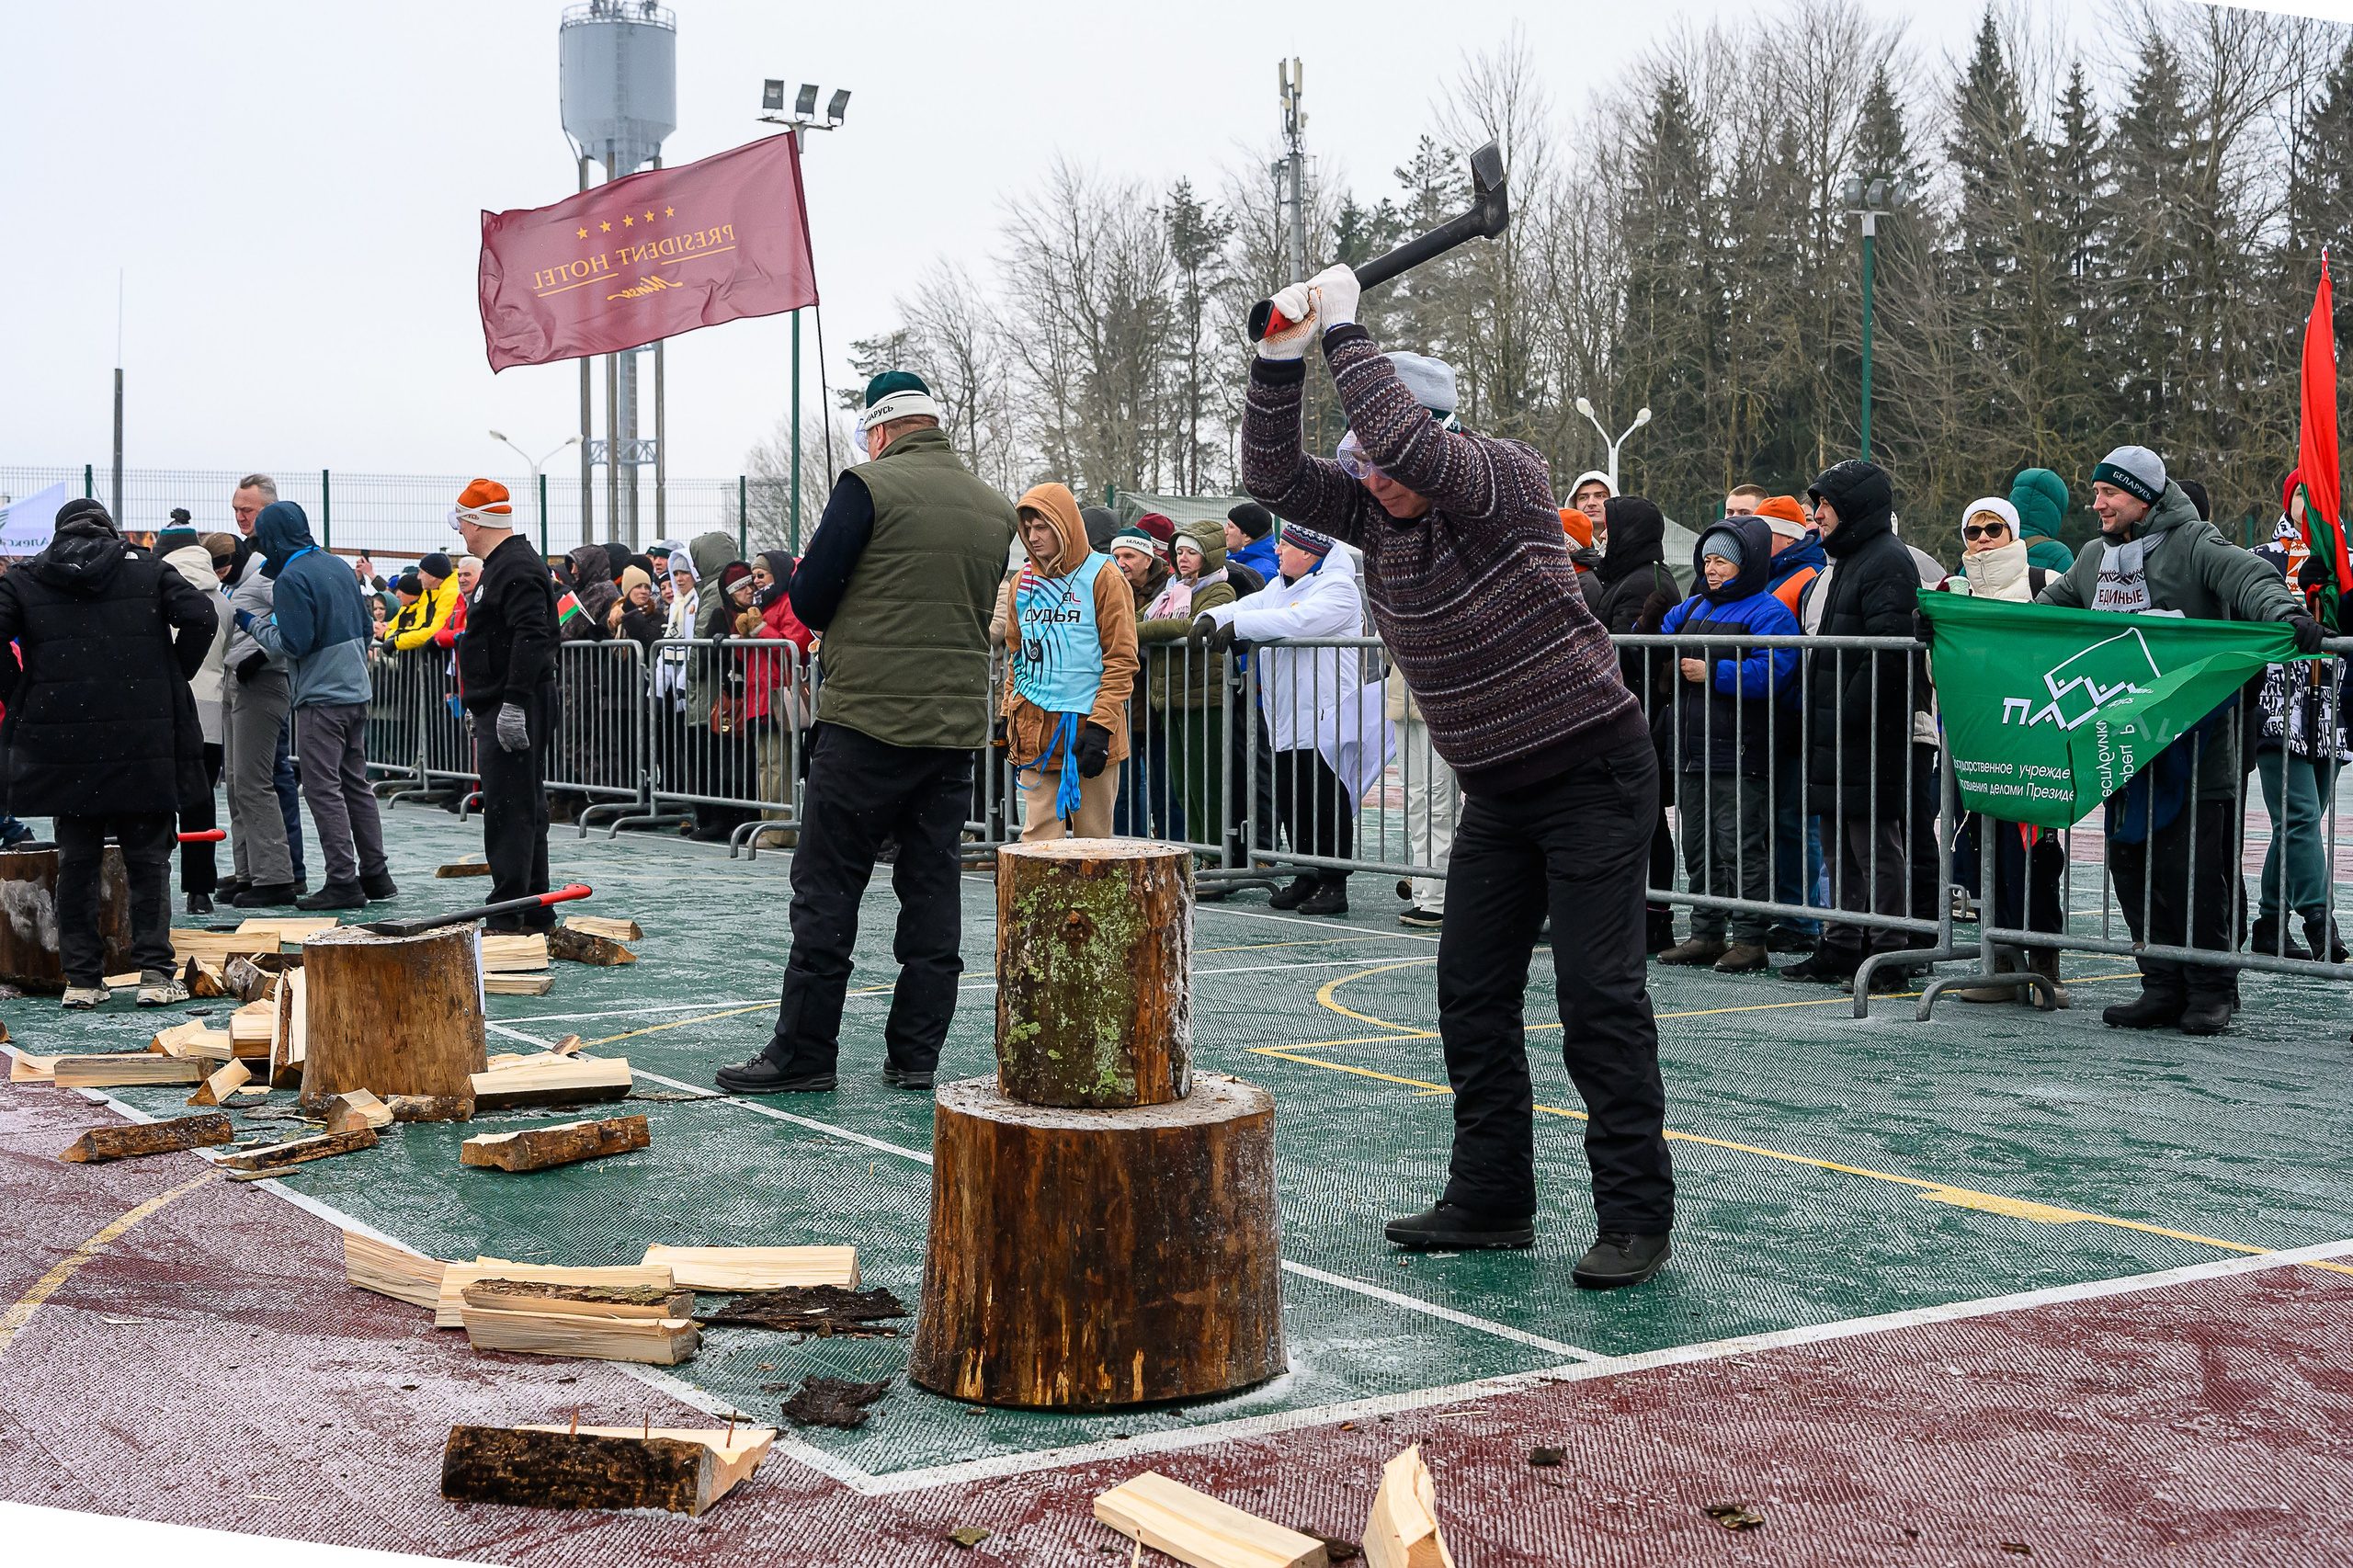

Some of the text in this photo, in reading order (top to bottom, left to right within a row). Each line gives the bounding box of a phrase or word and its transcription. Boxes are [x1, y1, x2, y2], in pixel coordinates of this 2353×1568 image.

[2113, 471, 2152, 500] БЕЛАРУСЬ
[2098, 589, 2144, 606] ЕДИНЫЕ
[1025, 608, 1082, 625] СУДЬЯ
[1952, 755, 2013, 775] осударственное
[1990, 783, 2024, 797] делами
